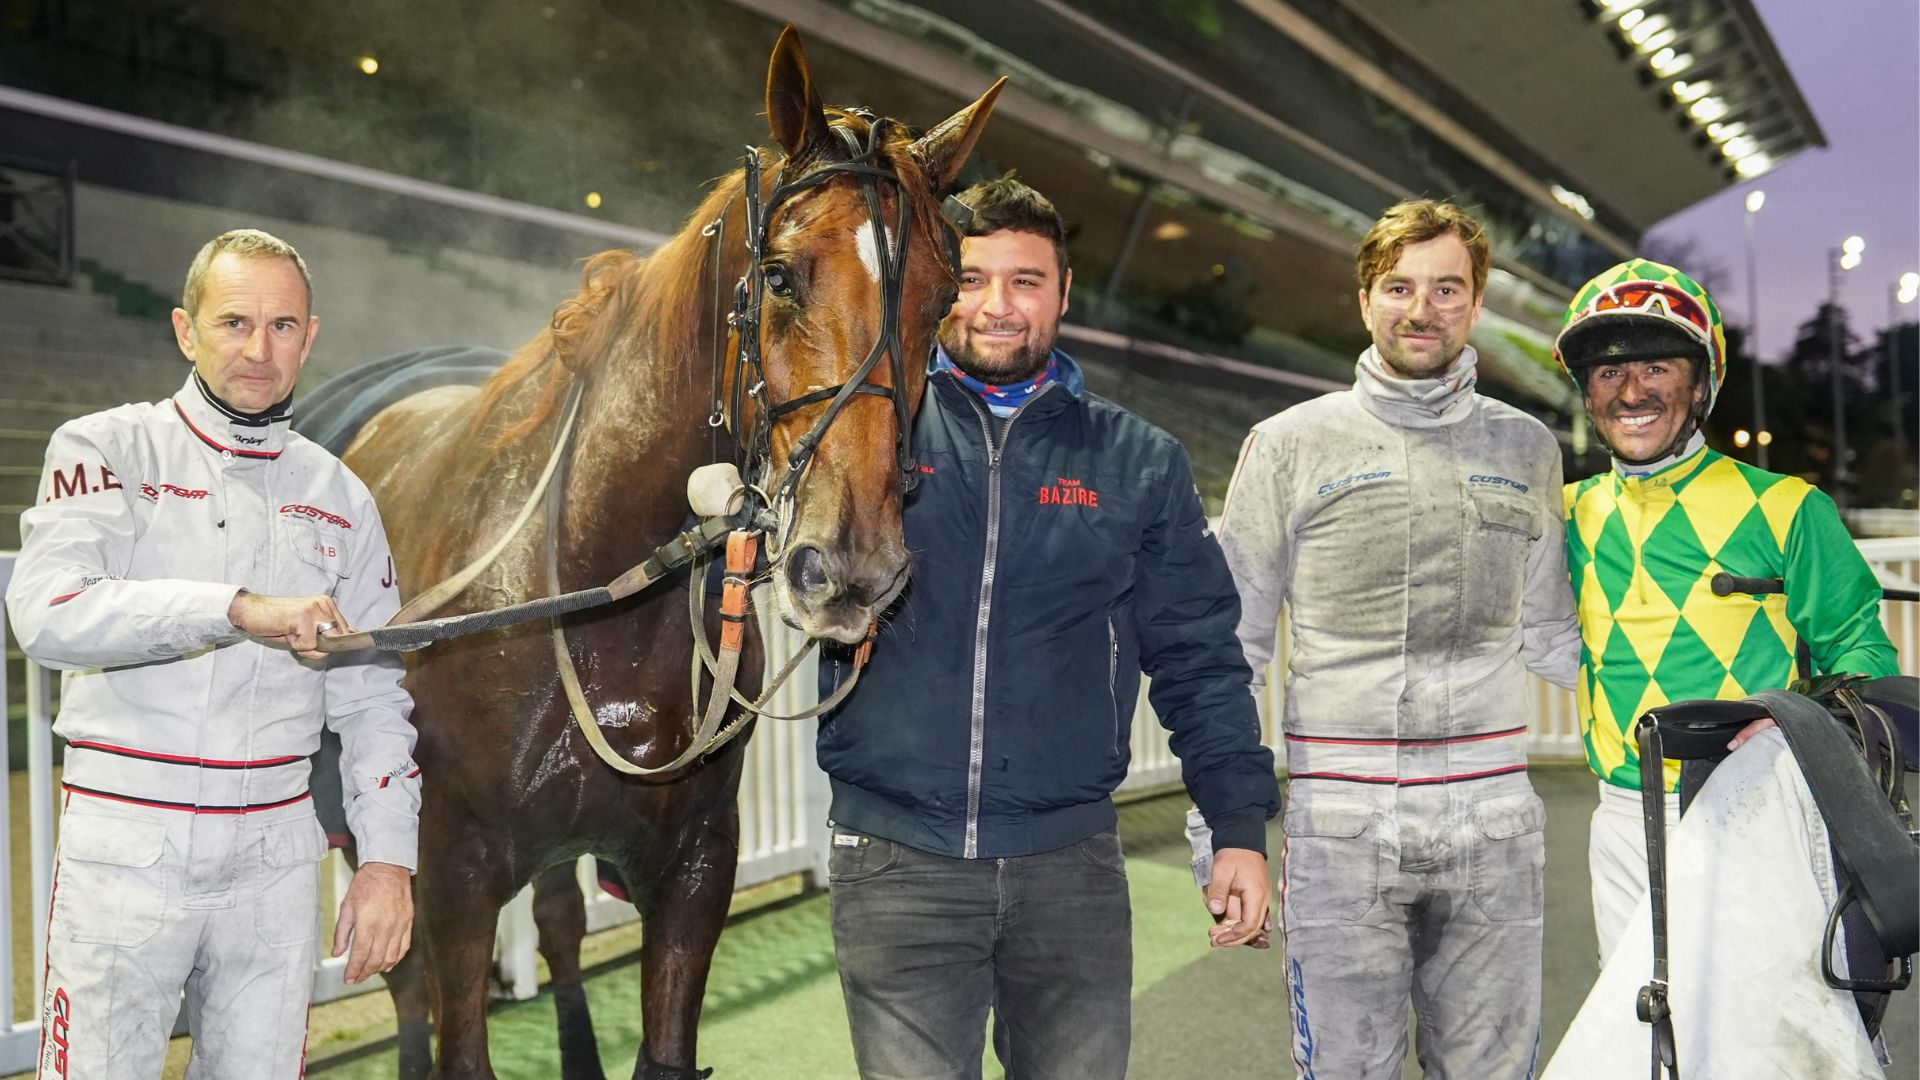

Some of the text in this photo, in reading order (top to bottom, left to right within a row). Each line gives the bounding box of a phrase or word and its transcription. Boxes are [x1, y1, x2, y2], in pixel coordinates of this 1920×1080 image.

[1057, 477, 1081, 487] TEAM
[1318, 471, 1391, 494] CUSTOM
[1469, 474, 1529, 494] CUSTOM
[1040, 486, 1098, 508] BAZIRE
[280, 504, 353, 529] CUSTOM
